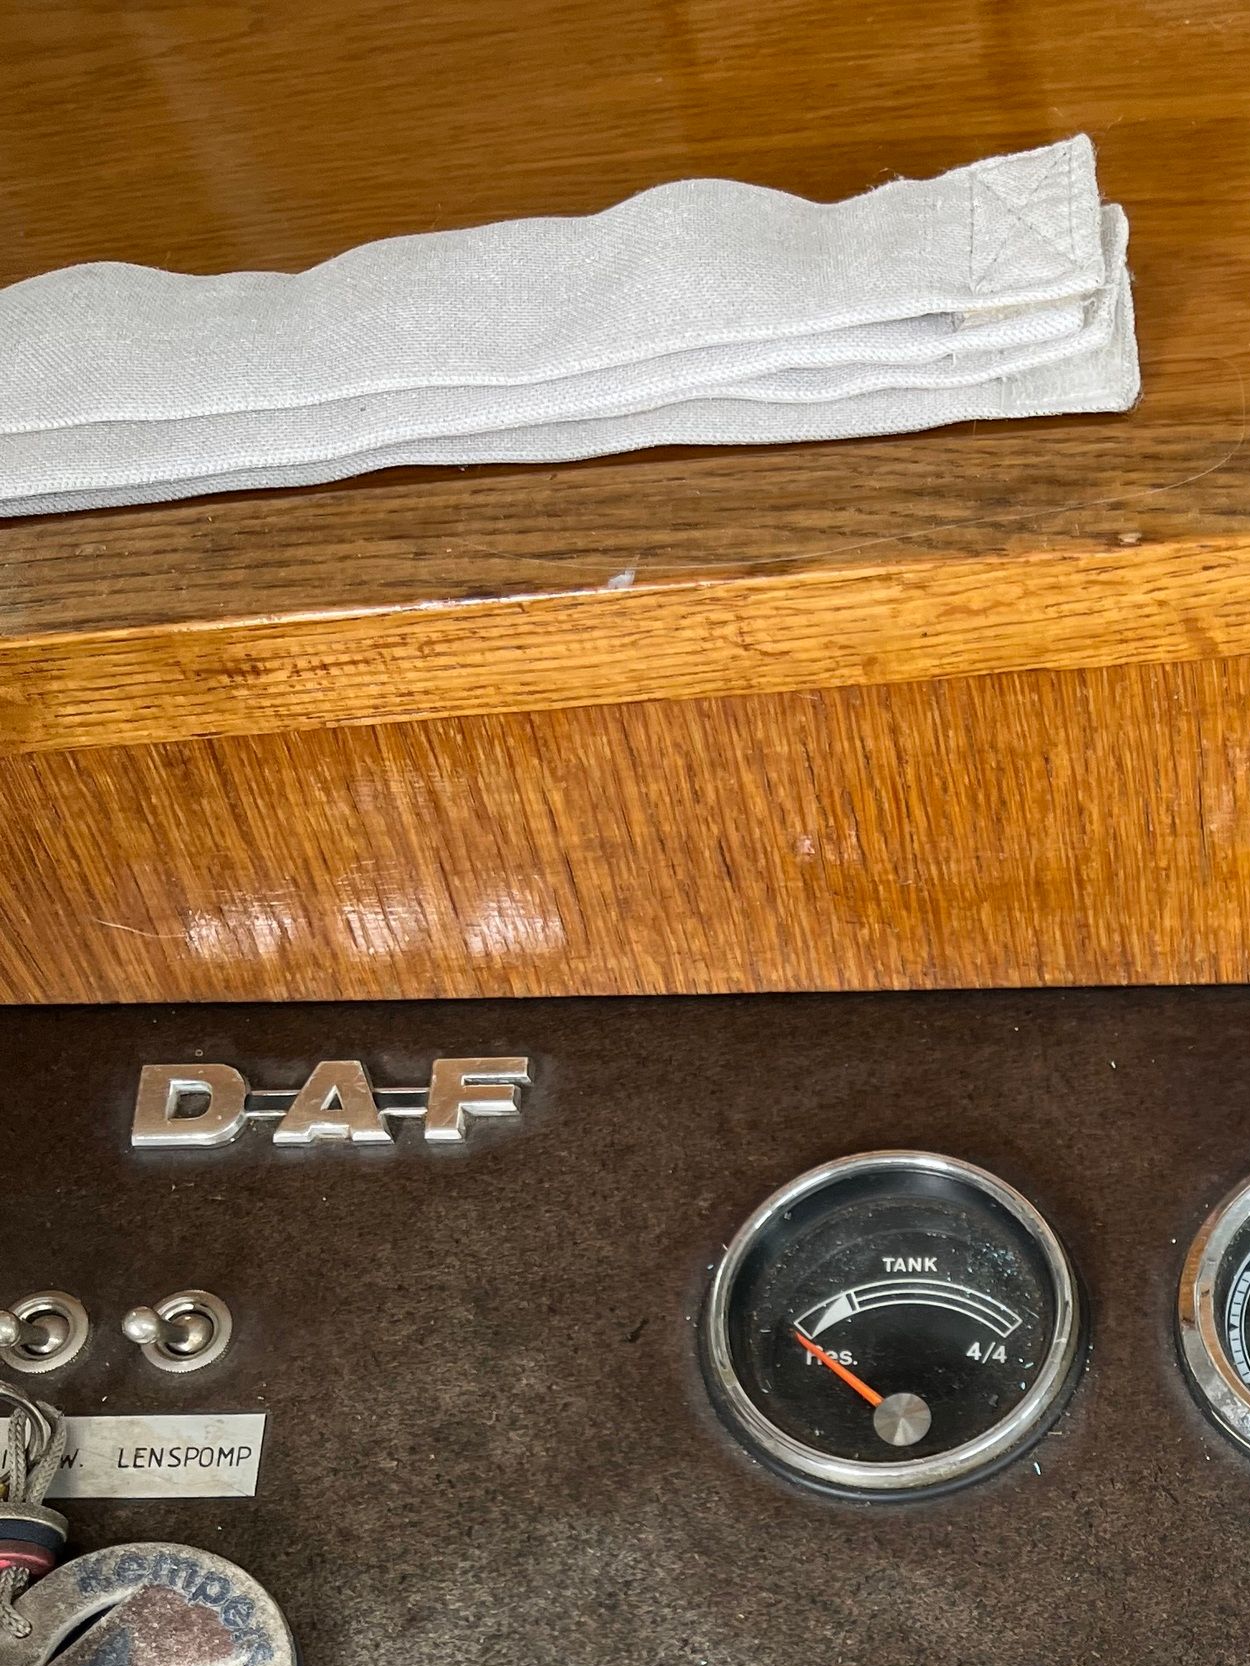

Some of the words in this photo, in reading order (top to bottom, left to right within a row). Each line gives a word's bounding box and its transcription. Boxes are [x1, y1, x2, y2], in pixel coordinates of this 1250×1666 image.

[132, 1056, 536, 1147] DAF
[882, 1257, 938, 1273] TANK
[966, 1341, 1007, 1364] 4/4
[117, 1445, 253, 1469] LENSPOMP
